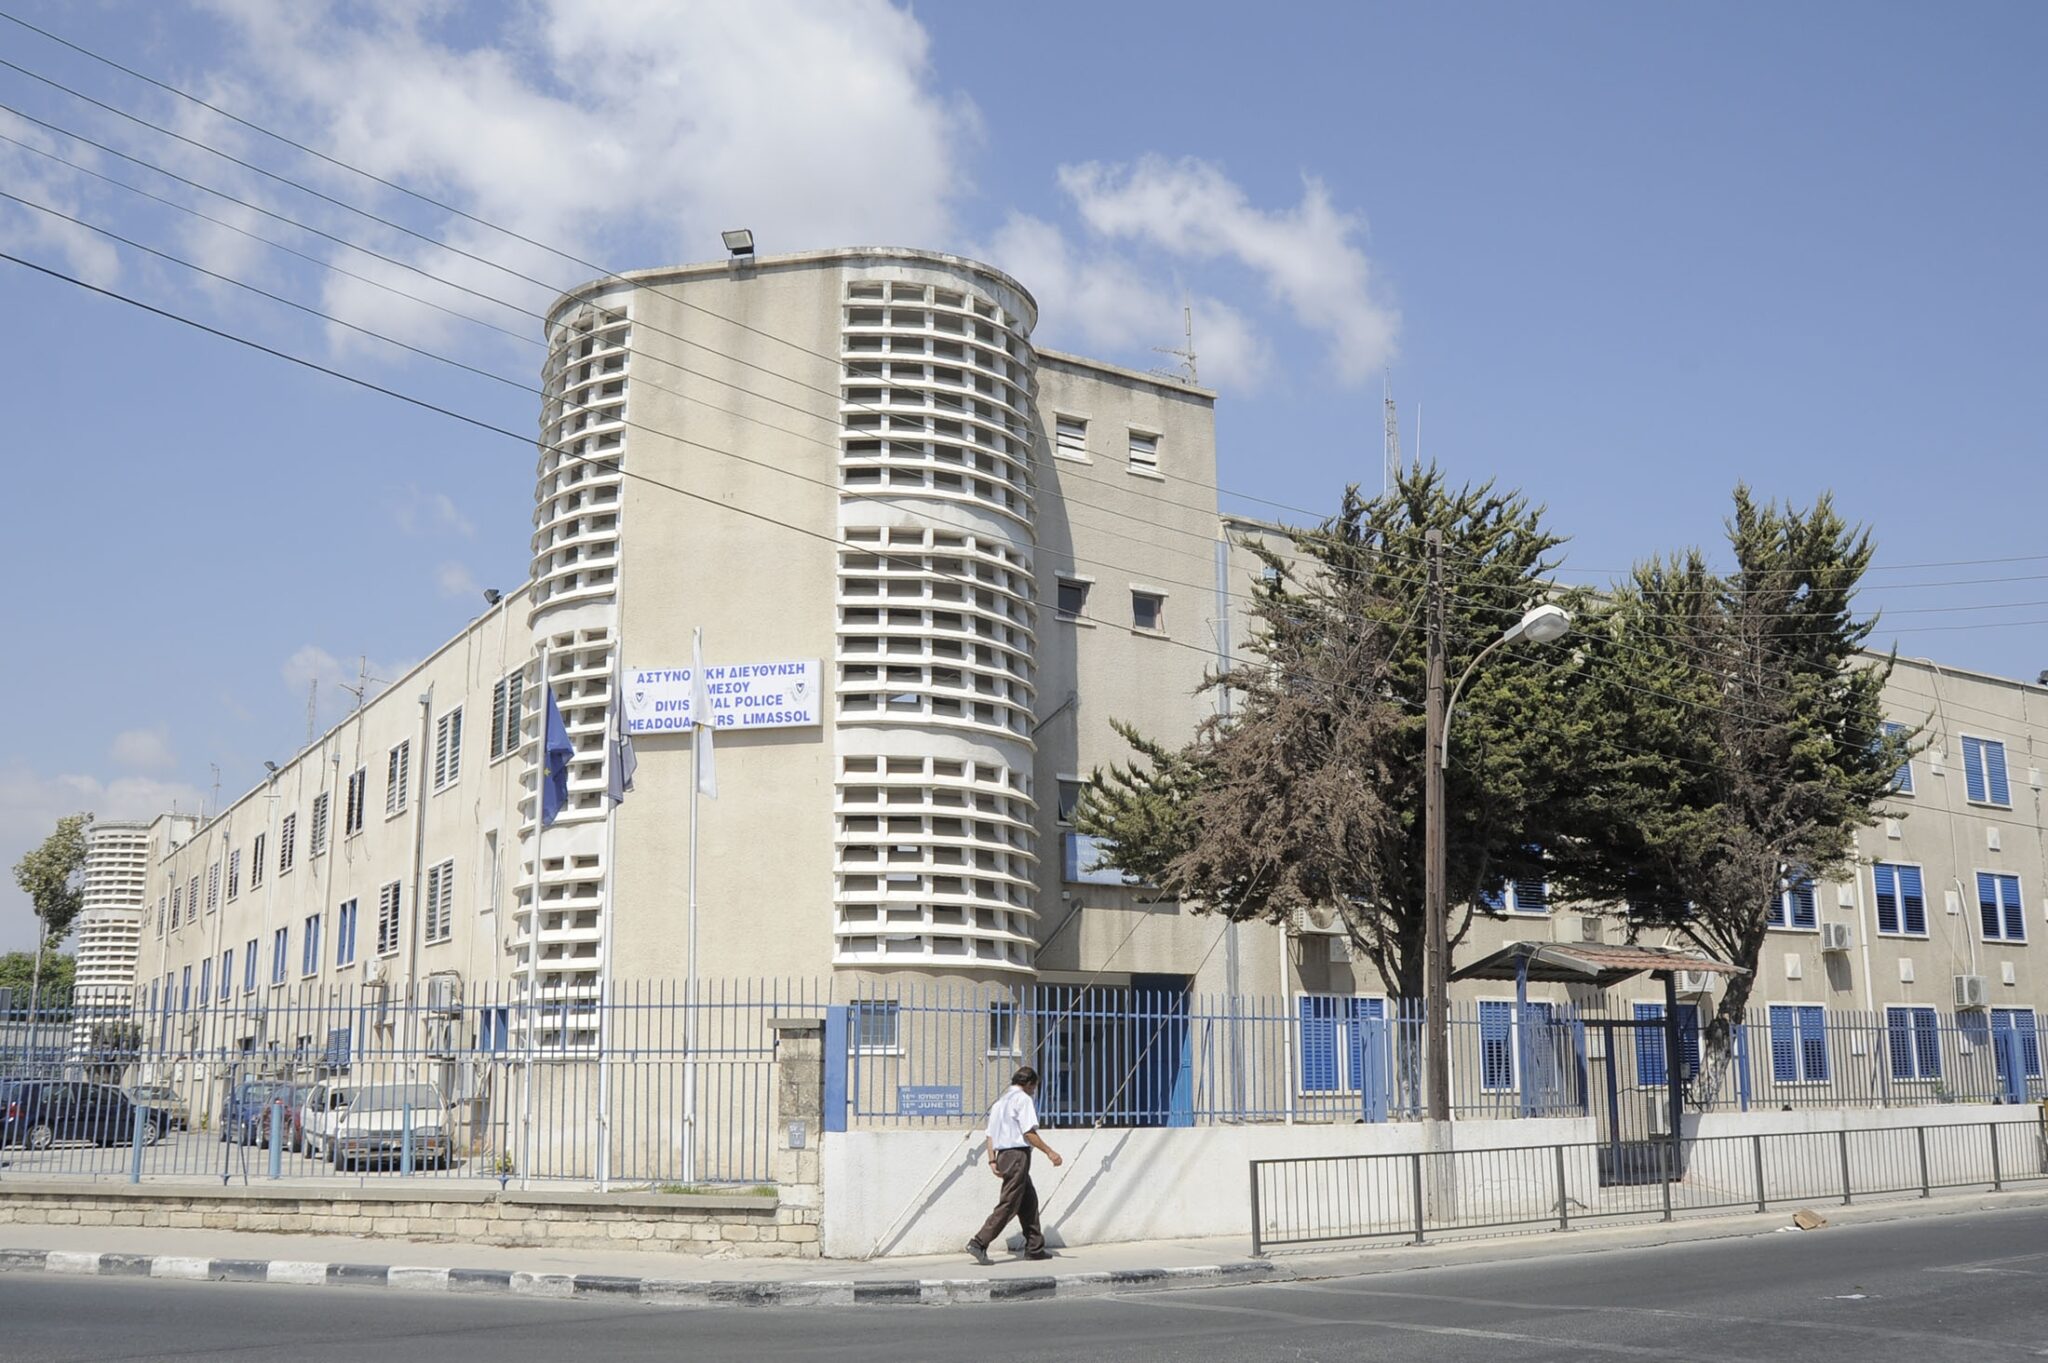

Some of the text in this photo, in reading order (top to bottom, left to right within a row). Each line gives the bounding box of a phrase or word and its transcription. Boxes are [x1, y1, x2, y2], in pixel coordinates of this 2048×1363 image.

[637, 663, 805, 684] ΑΣΤΥΝΟΚΗ ΔΙΕΥΘΥΝΣΗ
[655, 694, 783, 712] DIVISAL POLICE
[628, 710, 810, 731] HEADQUARS LIMASSOL
